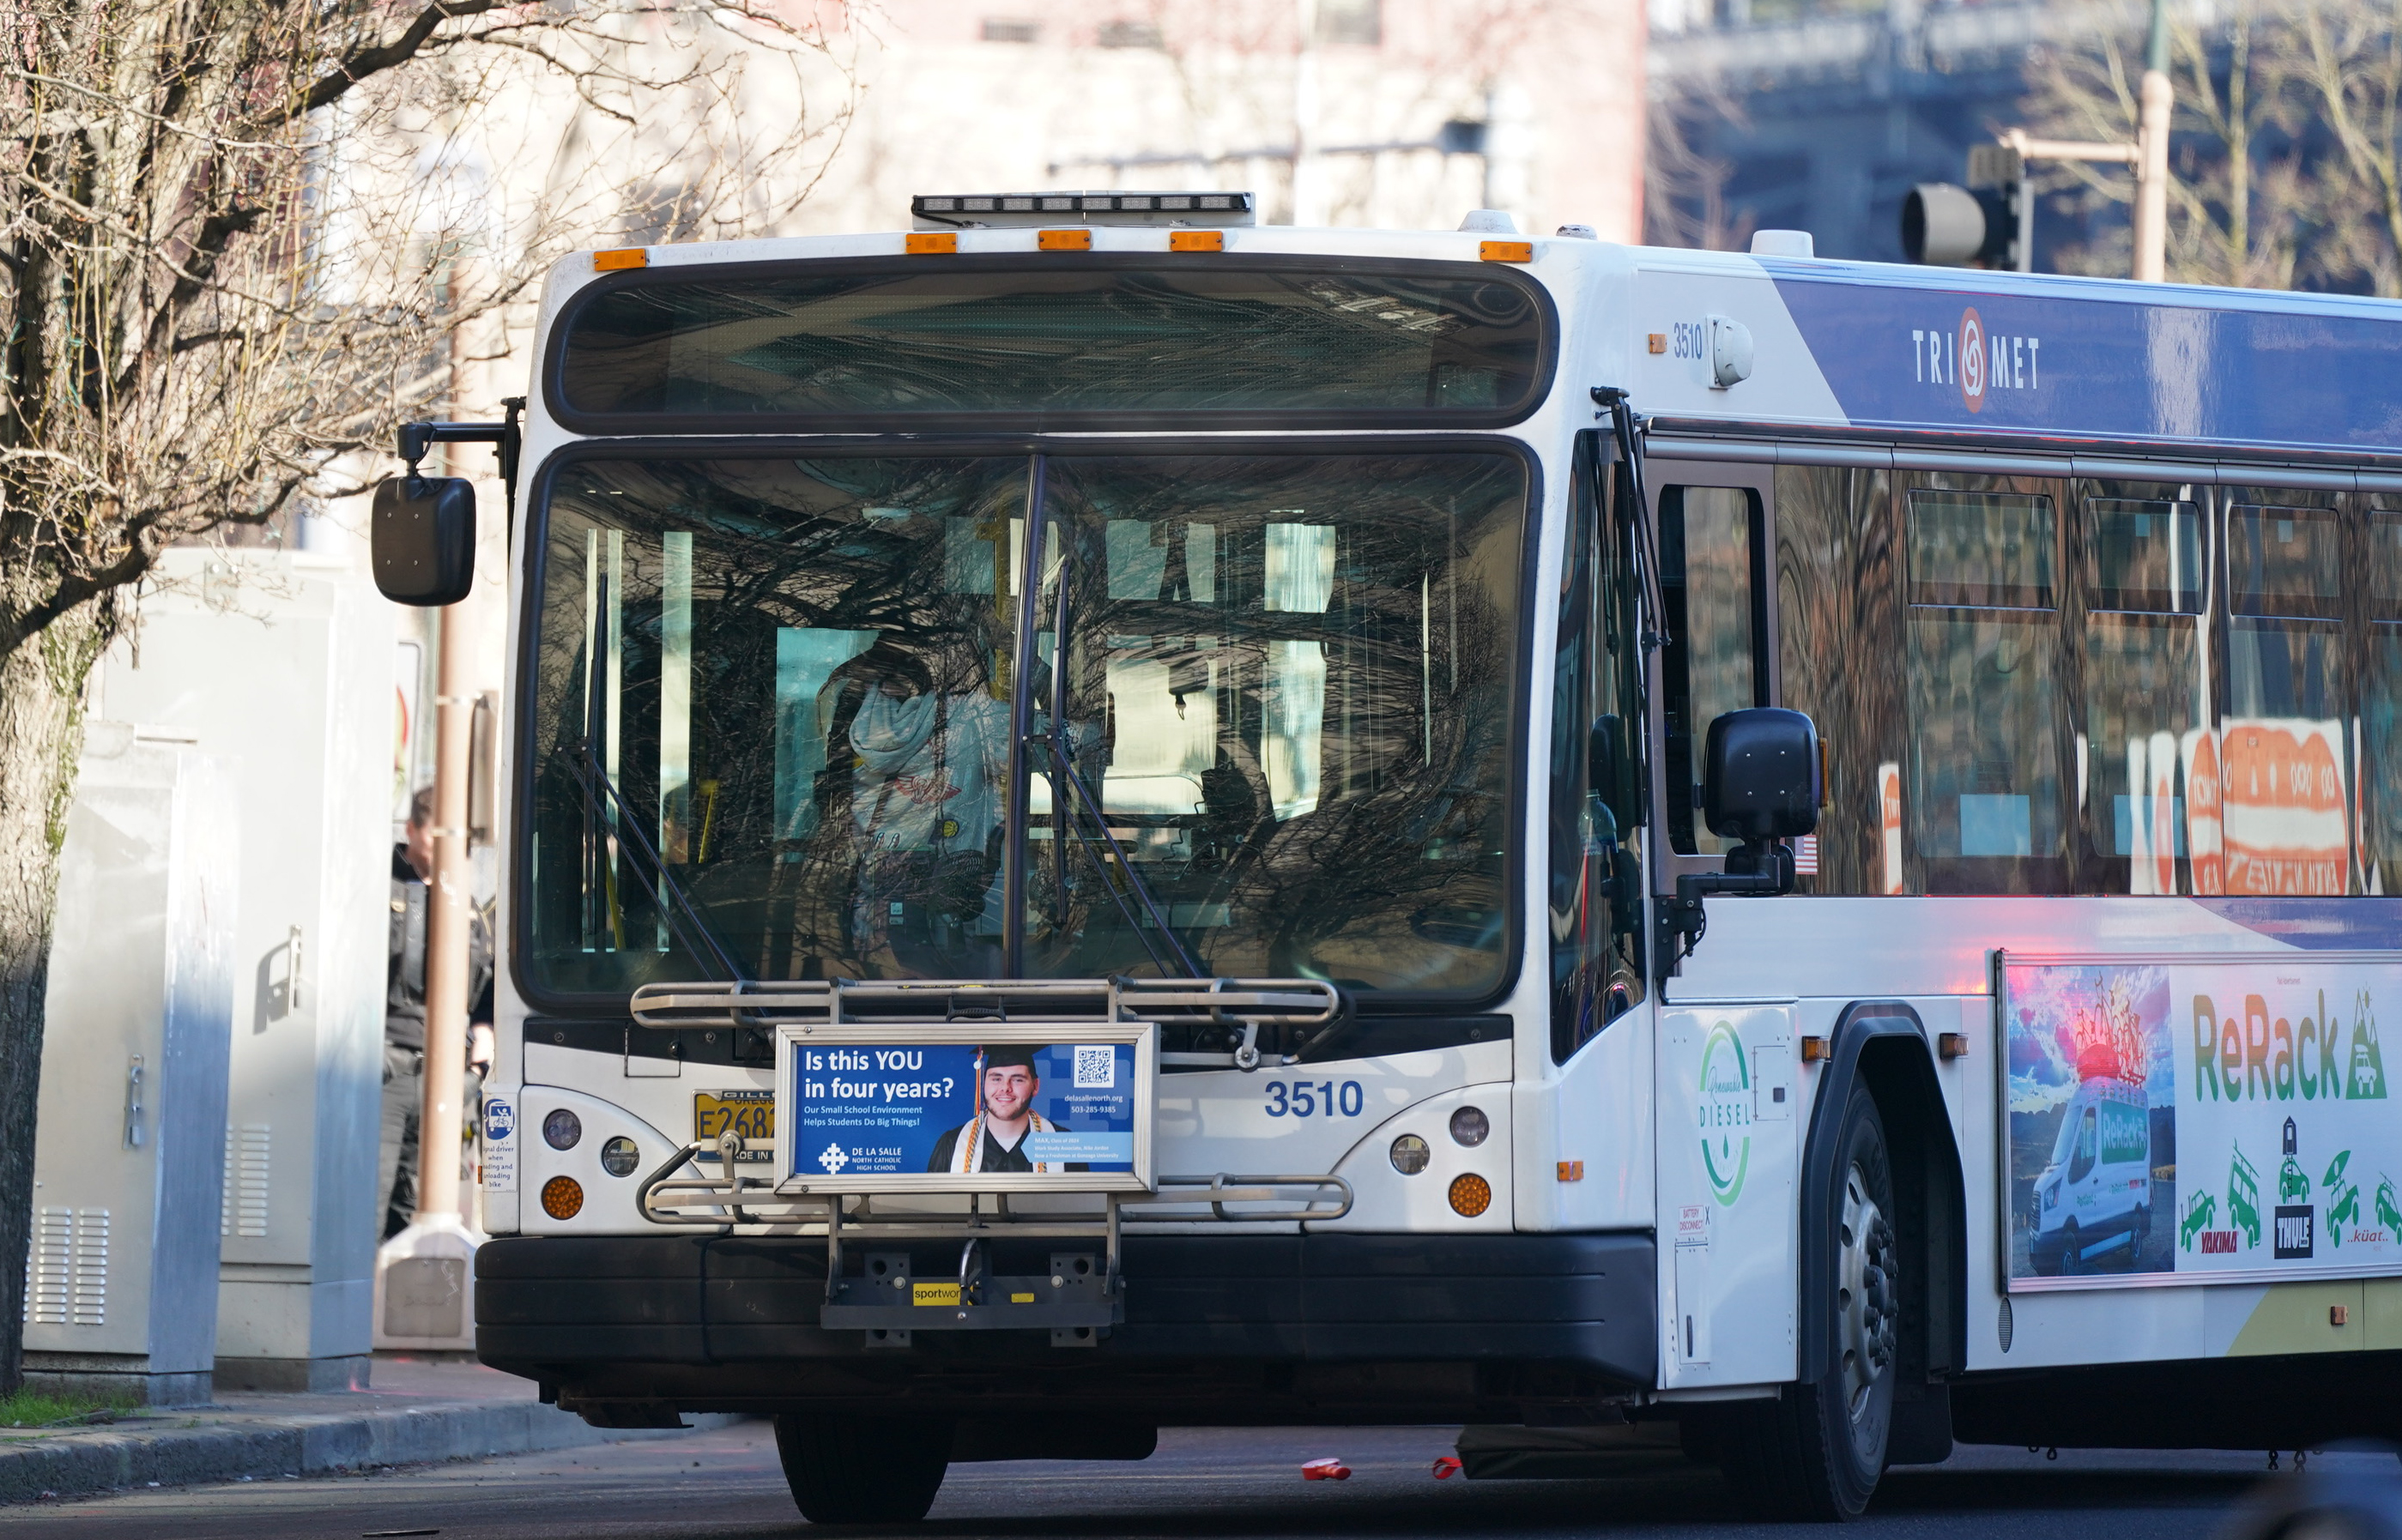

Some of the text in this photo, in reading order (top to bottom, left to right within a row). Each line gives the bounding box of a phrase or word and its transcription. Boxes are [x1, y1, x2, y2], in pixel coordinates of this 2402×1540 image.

[1674, 322, 1703, 360] 3510
[2193, 987, 2340, 1102] ReRack
[805, 1049, 923, 1071] Is this YOU
[805, 1077, 954, 1102] in four years?
[1707, 1066, 1741, 1104] Renewable
[804, 1105, 923, 1114] Our Small School Environment
[1064, 1094, 1123, 1103] delasallenorth.org
[1265, 1080, 1364, 1117] 3510
[699, 1107, 775, 1138] E268
[804, 1118, 826, 1127] Helps
[877, 1118, 890, 1127] Big
[891, 1118, 920, 1127] Things!
[1699, 1103, 1750, 1128] DIESEL
[2103, 1113, 2138, 1149] ReRack
[852, 1147, 902, 1156] DE LA SALLE
[1679, 1219, 1703, 1231] DISCONNECT
[1683, 1209, 1700, 1218] BATTERY
[2200, 1230, 2237, 1254] YAKIMA
[2277, 1217, 2310, 1249] THULE
